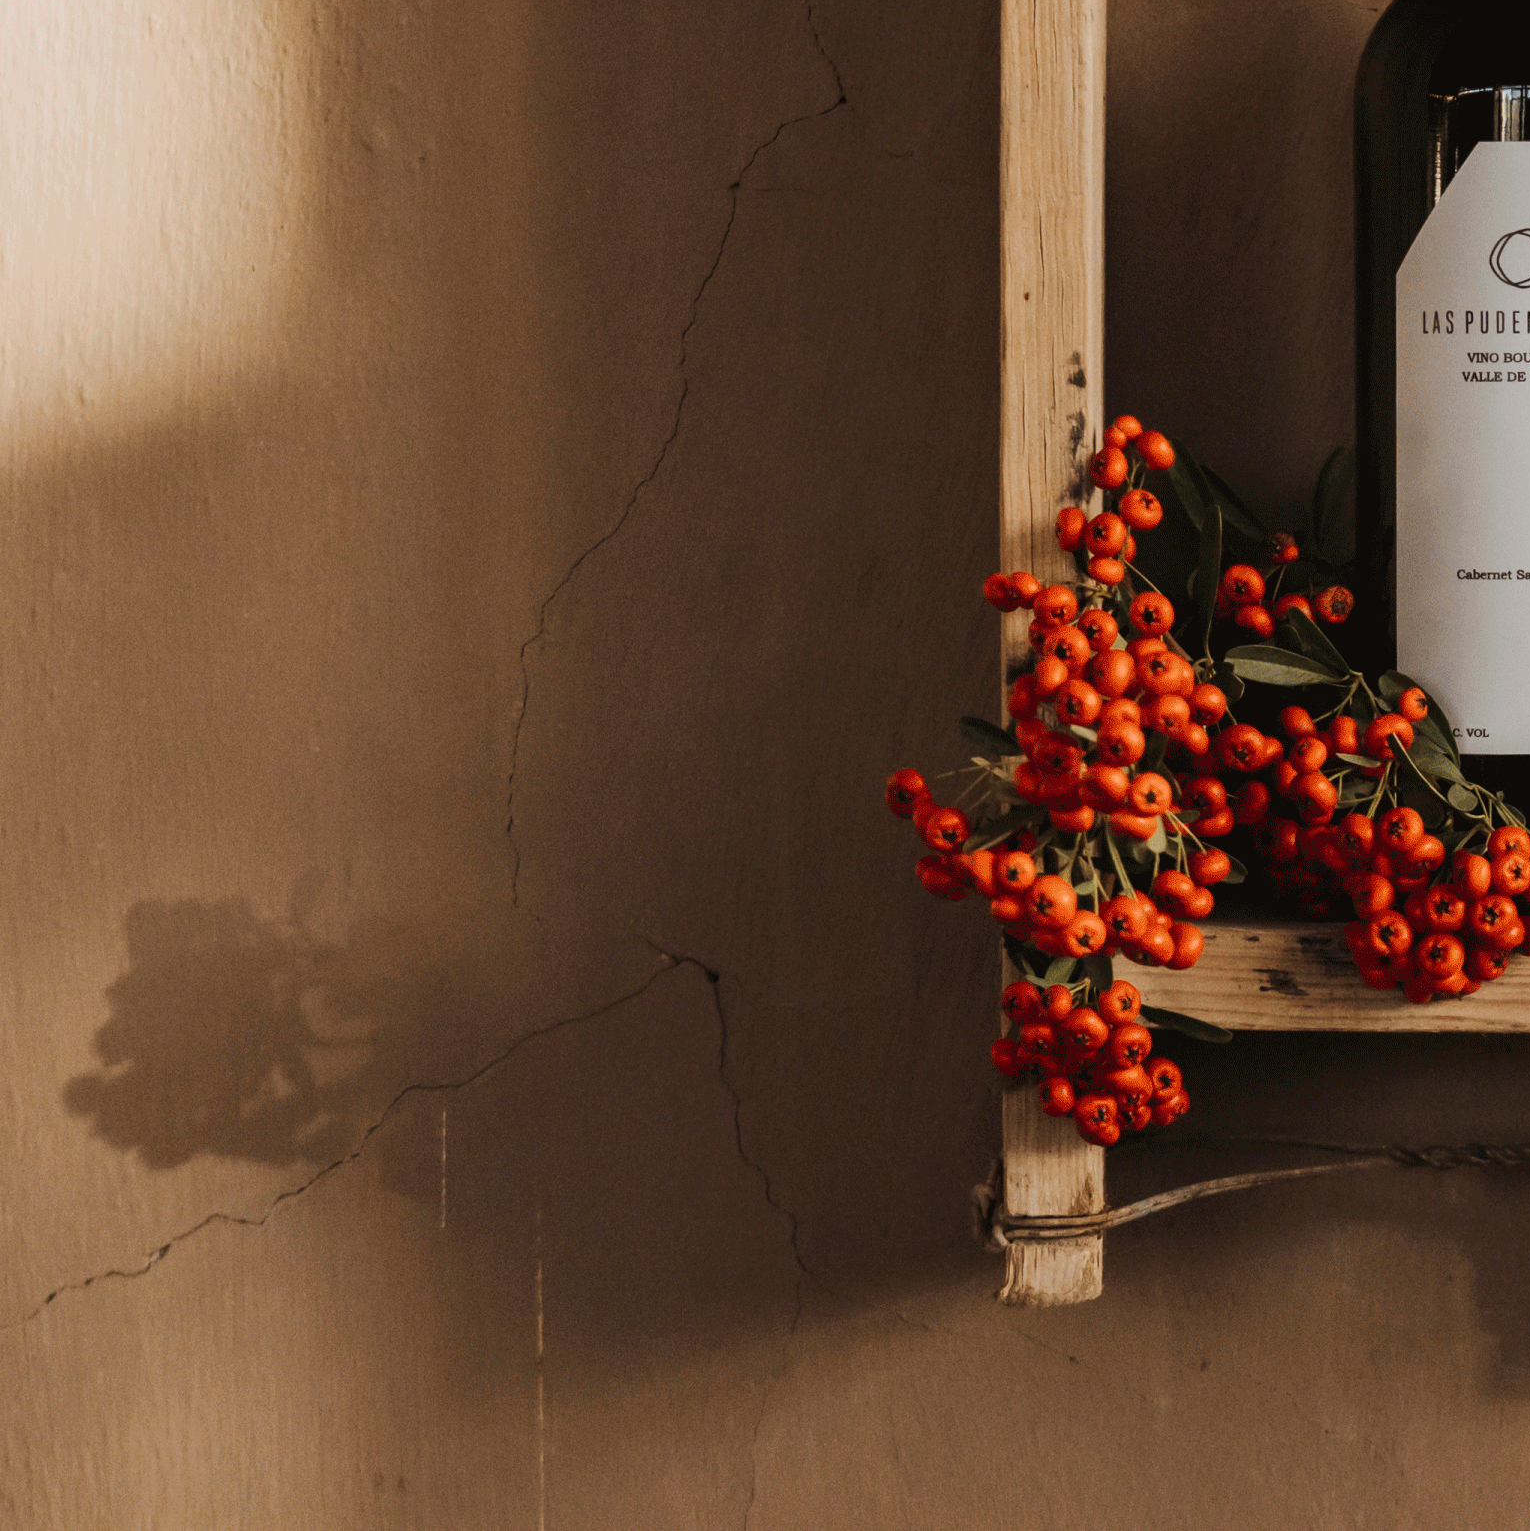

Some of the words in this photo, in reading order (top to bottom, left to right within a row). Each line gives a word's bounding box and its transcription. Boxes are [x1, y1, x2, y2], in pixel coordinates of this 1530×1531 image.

[1422, 310, 1454, 335] LAS
[1467, 352, 1500, 364] VINO
[1462, 371, 1503, 383] VALLE
[1507, 371, 1527, 383] DE
[1456, 568, 1512, 580] Cabernet
[1452, 727, 1463, 738] C.
[1466, 727, 1490, 738] VOL
